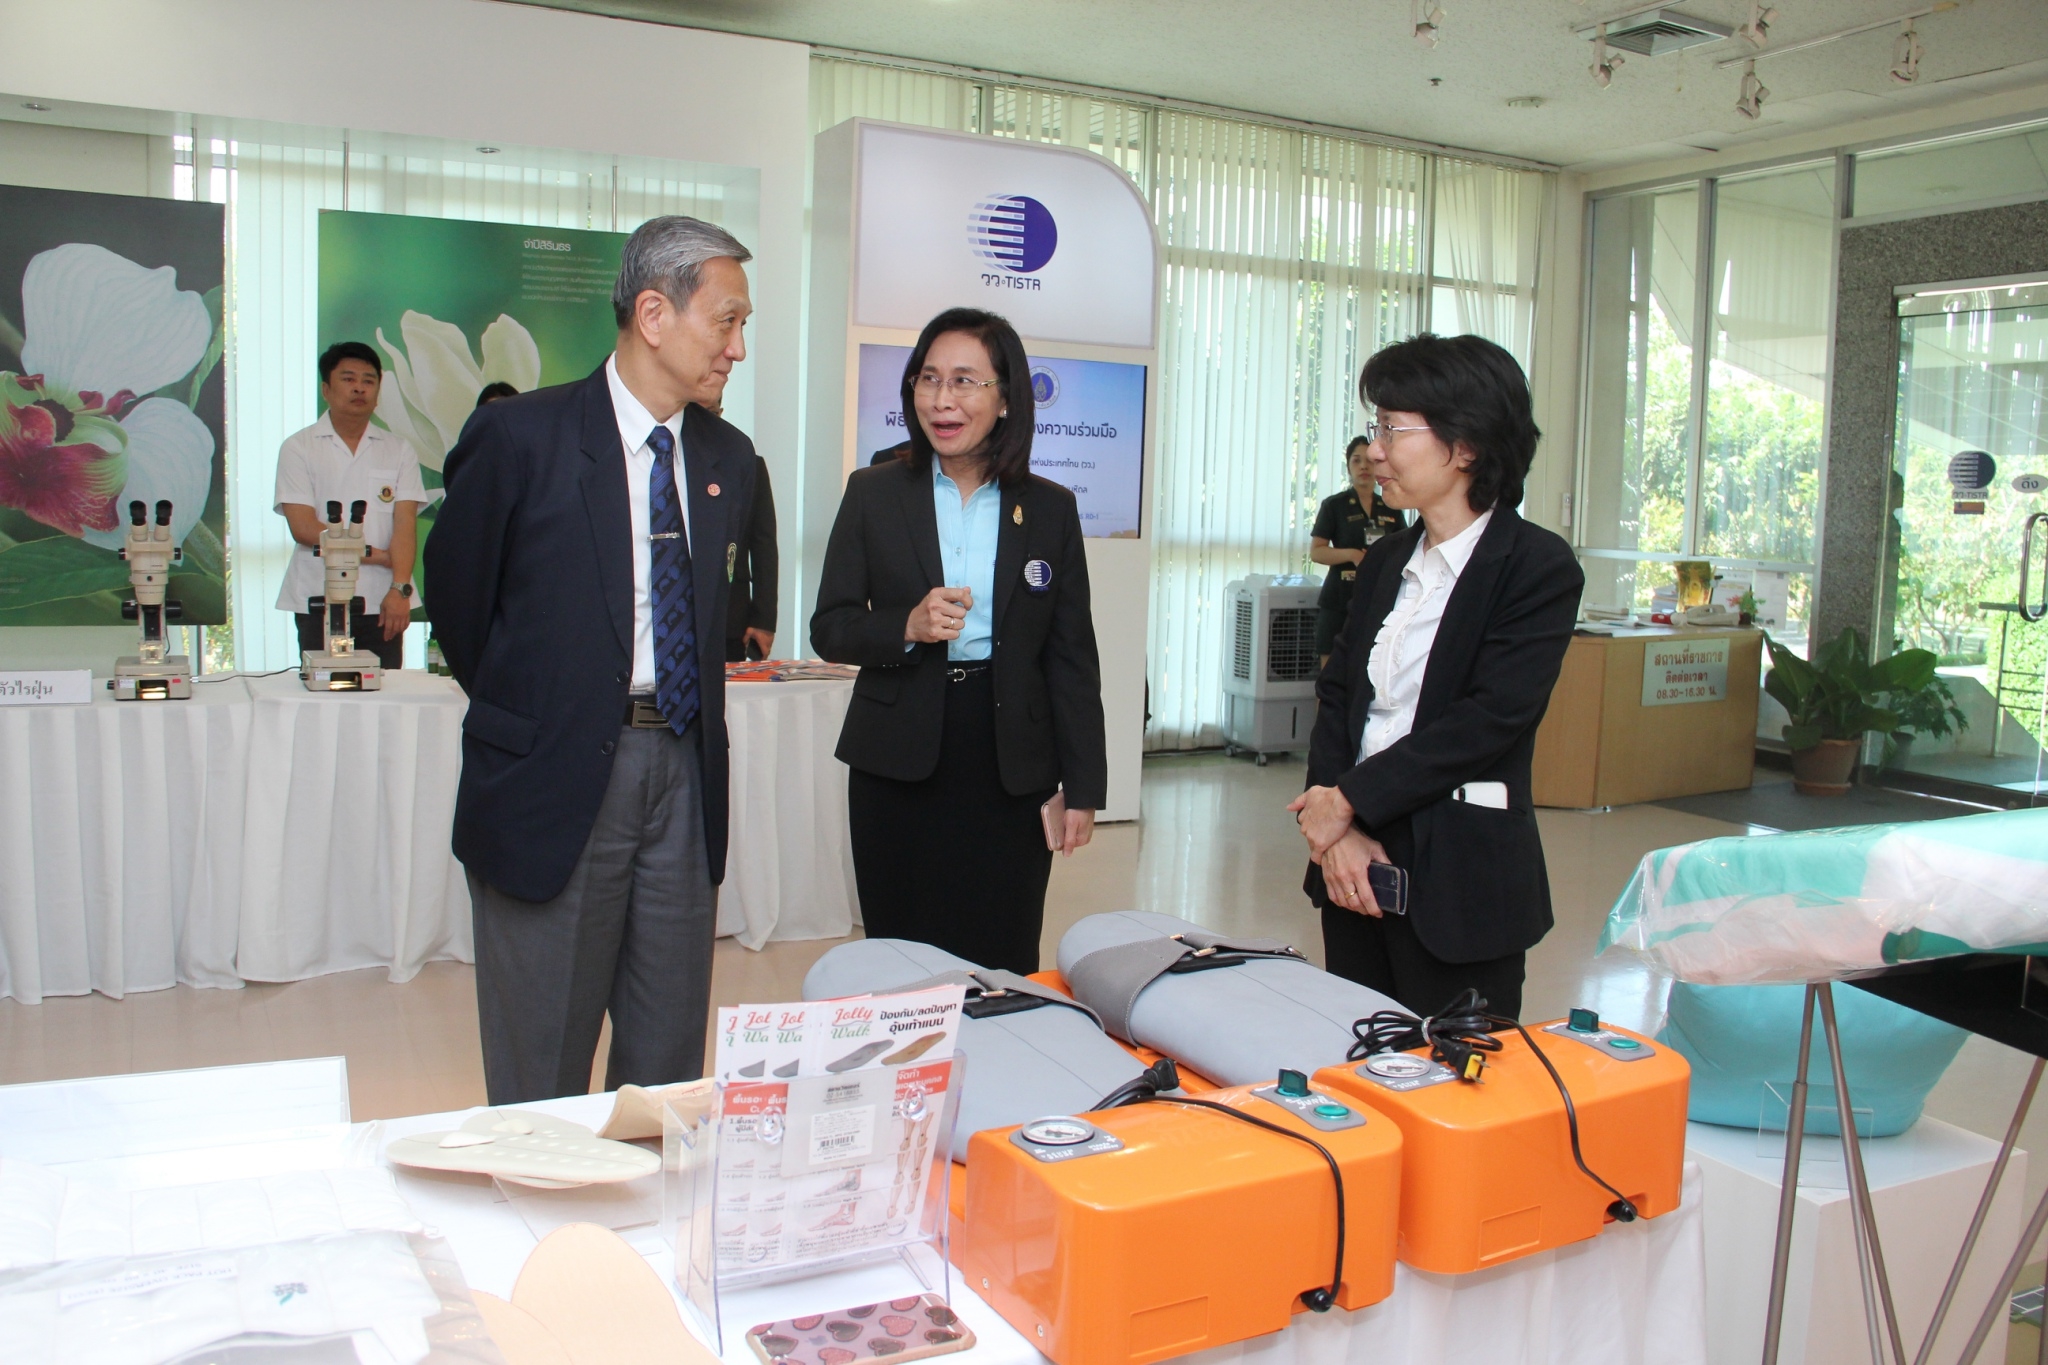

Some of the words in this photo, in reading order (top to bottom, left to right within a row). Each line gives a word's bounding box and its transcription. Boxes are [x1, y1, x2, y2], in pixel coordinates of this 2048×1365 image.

[1034, 421, 1117, 438] งความร่วมมือ
